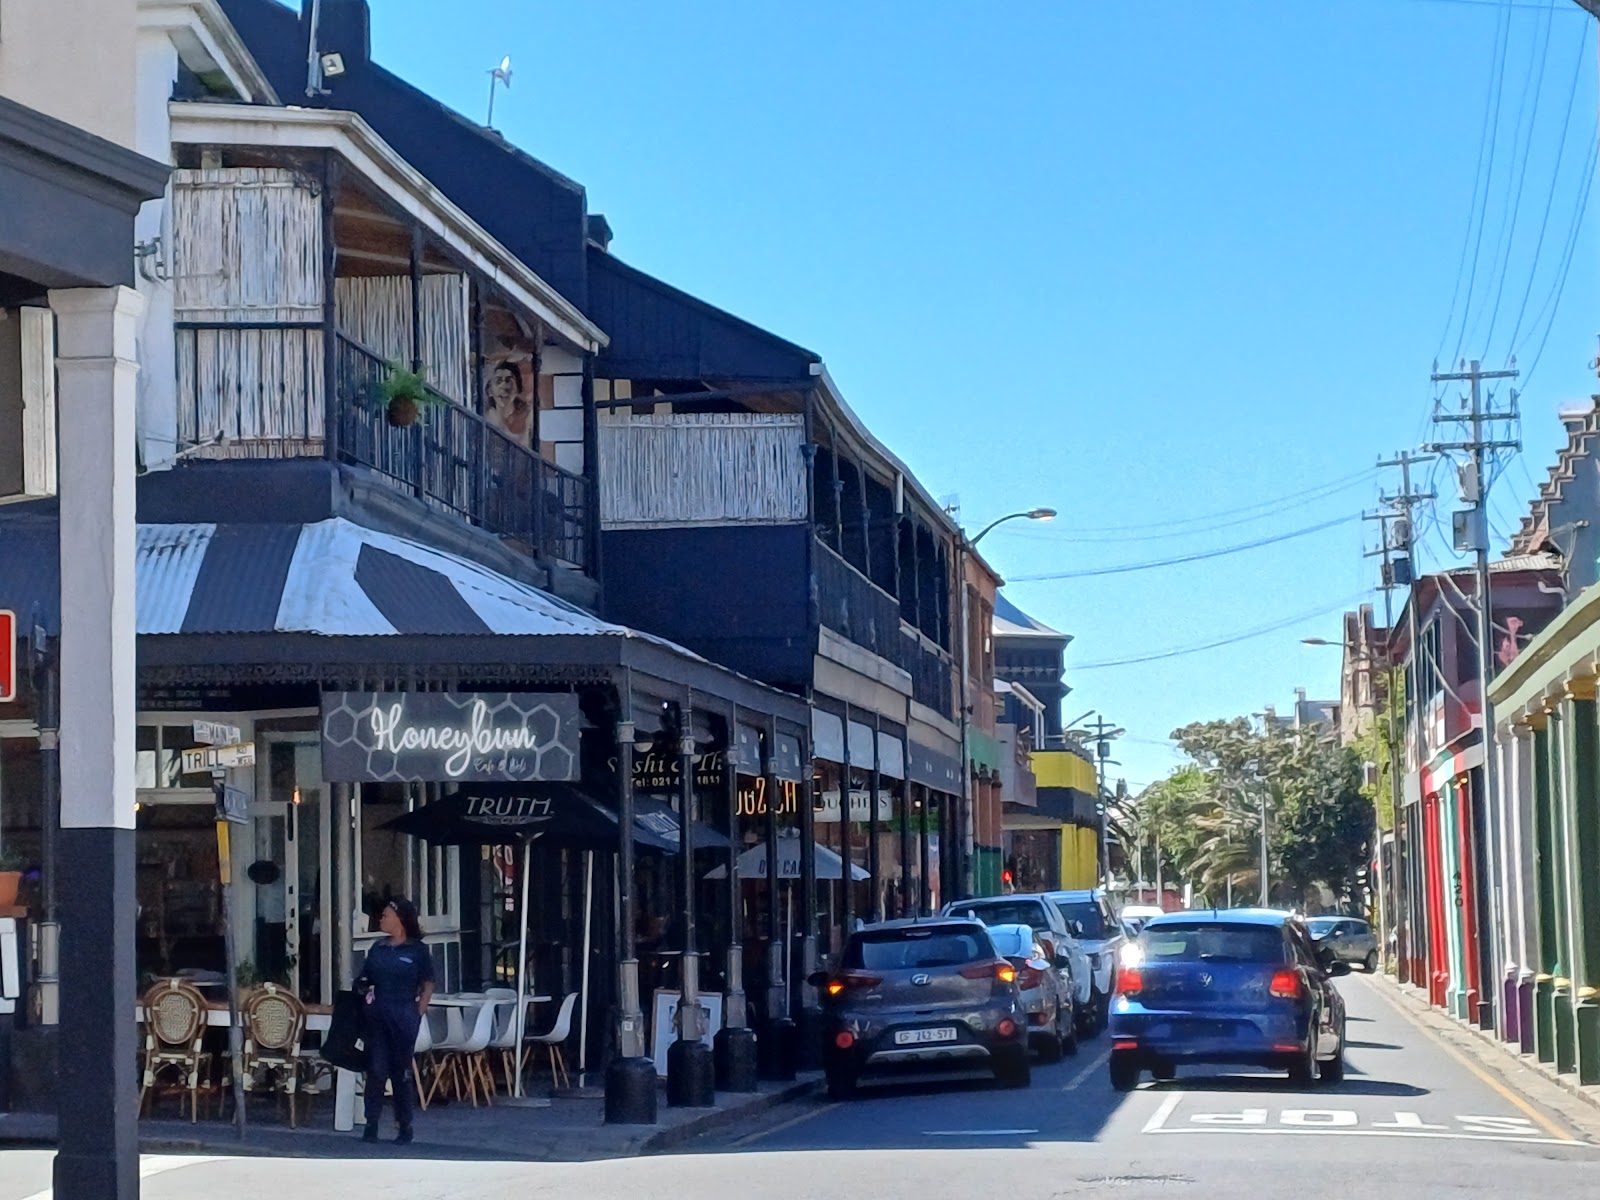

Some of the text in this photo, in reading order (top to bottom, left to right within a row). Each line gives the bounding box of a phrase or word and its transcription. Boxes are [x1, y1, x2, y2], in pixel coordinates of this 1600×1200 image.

[370, 699, 537, 777] Honeybun
[185, 748, 224, 770] TRILL
[651, 776, 671, 788] 021
[467, 796, 552, 816] TRUTH
[1190, 1108, 1542, 1135] STOP
